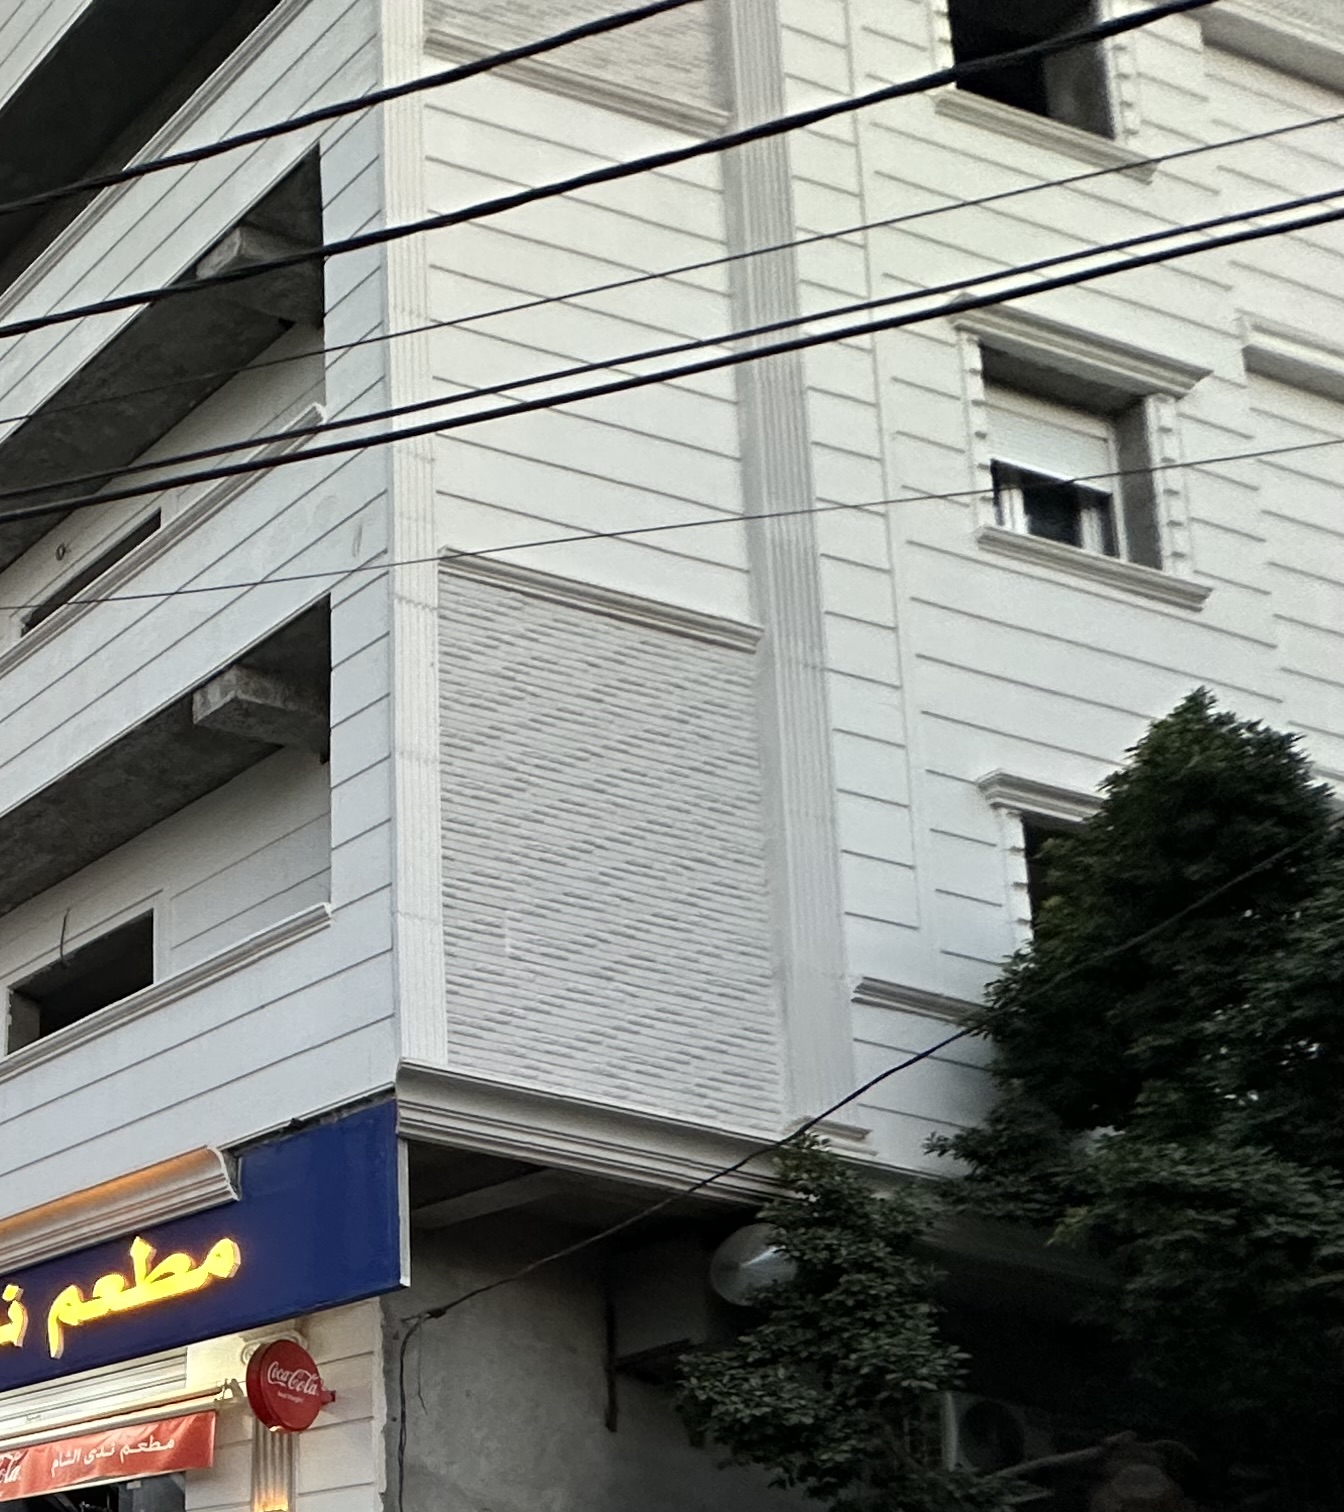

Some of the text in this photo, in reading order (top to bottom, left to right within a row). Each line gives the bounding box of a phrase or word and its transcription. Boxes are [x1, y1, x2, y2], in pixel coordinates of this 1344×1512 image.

[47, 1236, 241, 1359] مطعم
[51, 1435, 175, 1479] مطعم ندى الشام
